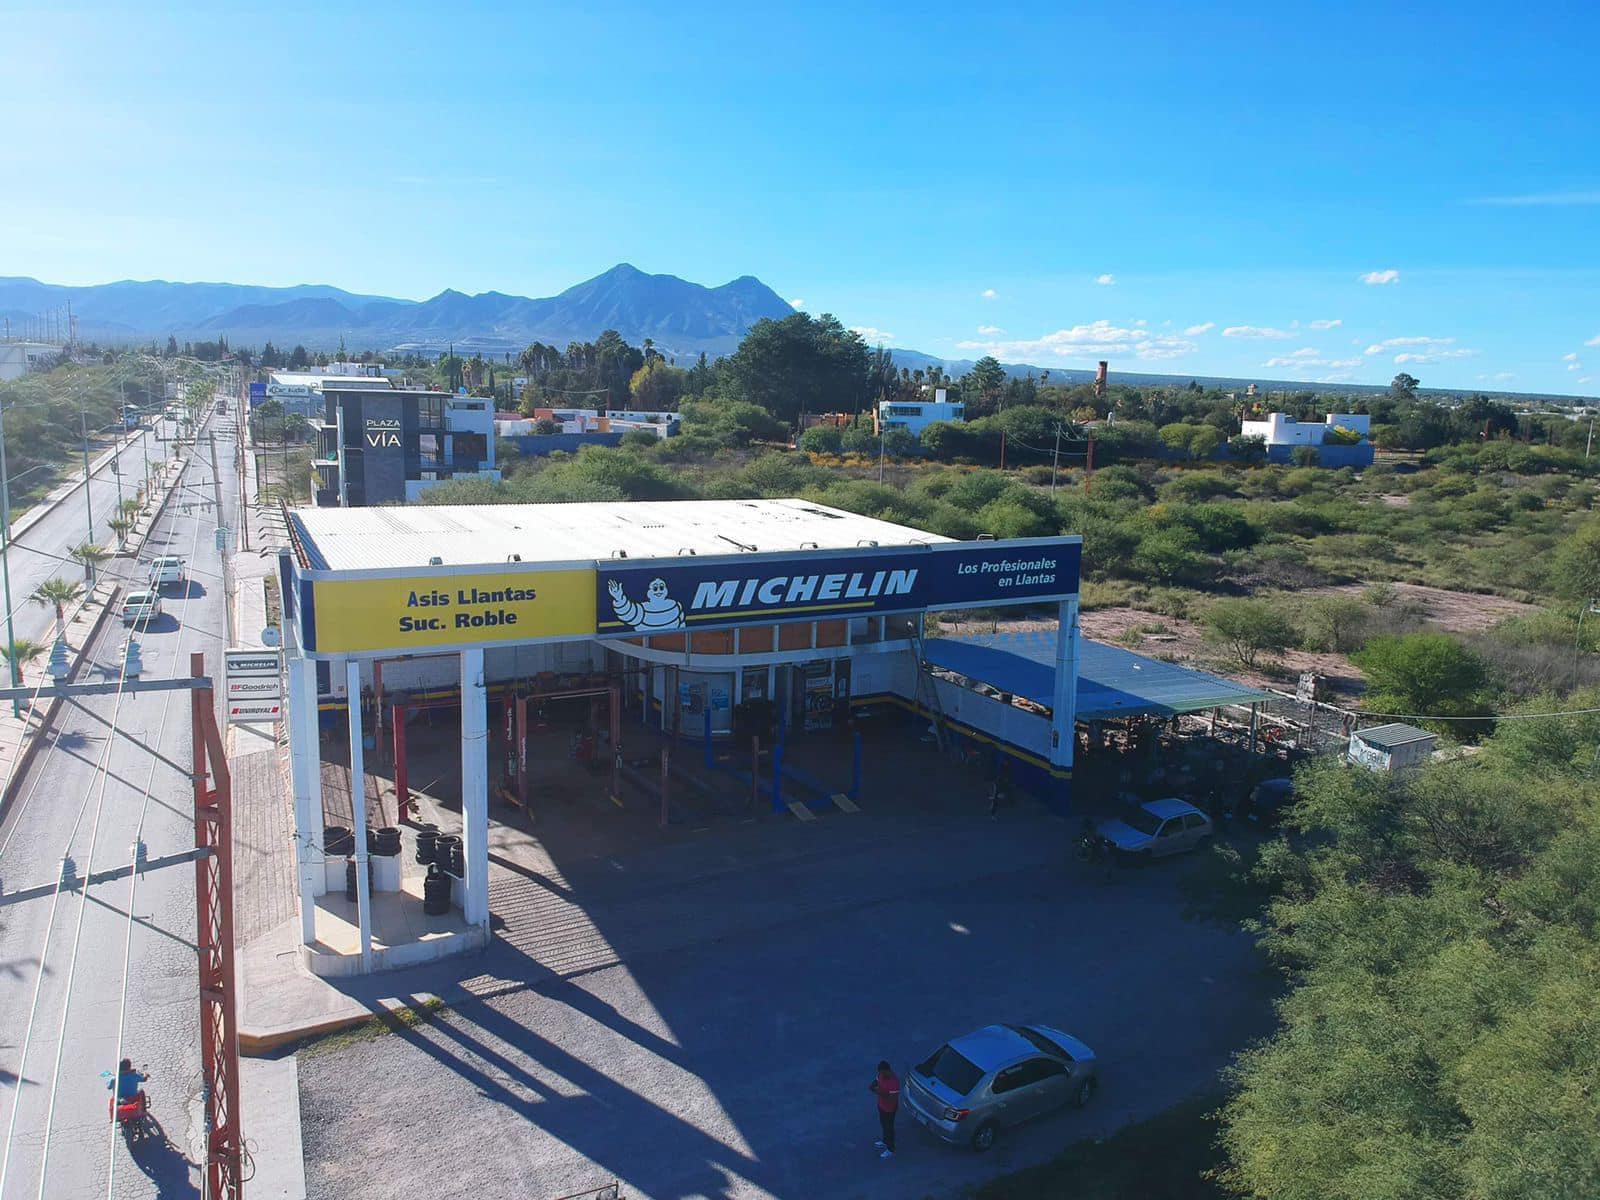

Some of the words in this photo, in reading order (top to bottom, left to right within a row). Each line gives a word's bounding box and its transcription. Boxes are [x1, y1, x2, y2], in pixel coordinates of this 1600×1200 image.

[366, 419, 401, 427] PLAZA
[366, 431, 401, 447] VÍA
[958, 562, 978, 574] Los
[980, 557, 1057, 573] Profesionales
[998, 576, 1012, 587] en
[1015, 573, 1056, 586] Llantas
[691, 568, 919, 609] MICHELIN
[407, 590, 450, 607] Asis
[457, 587, 537, 605] Llantas
[399, 616, 447, 632] Suc.
[455, 610, 518, 629] Roble
[230, 682, 278, 690] BFGoodrich
